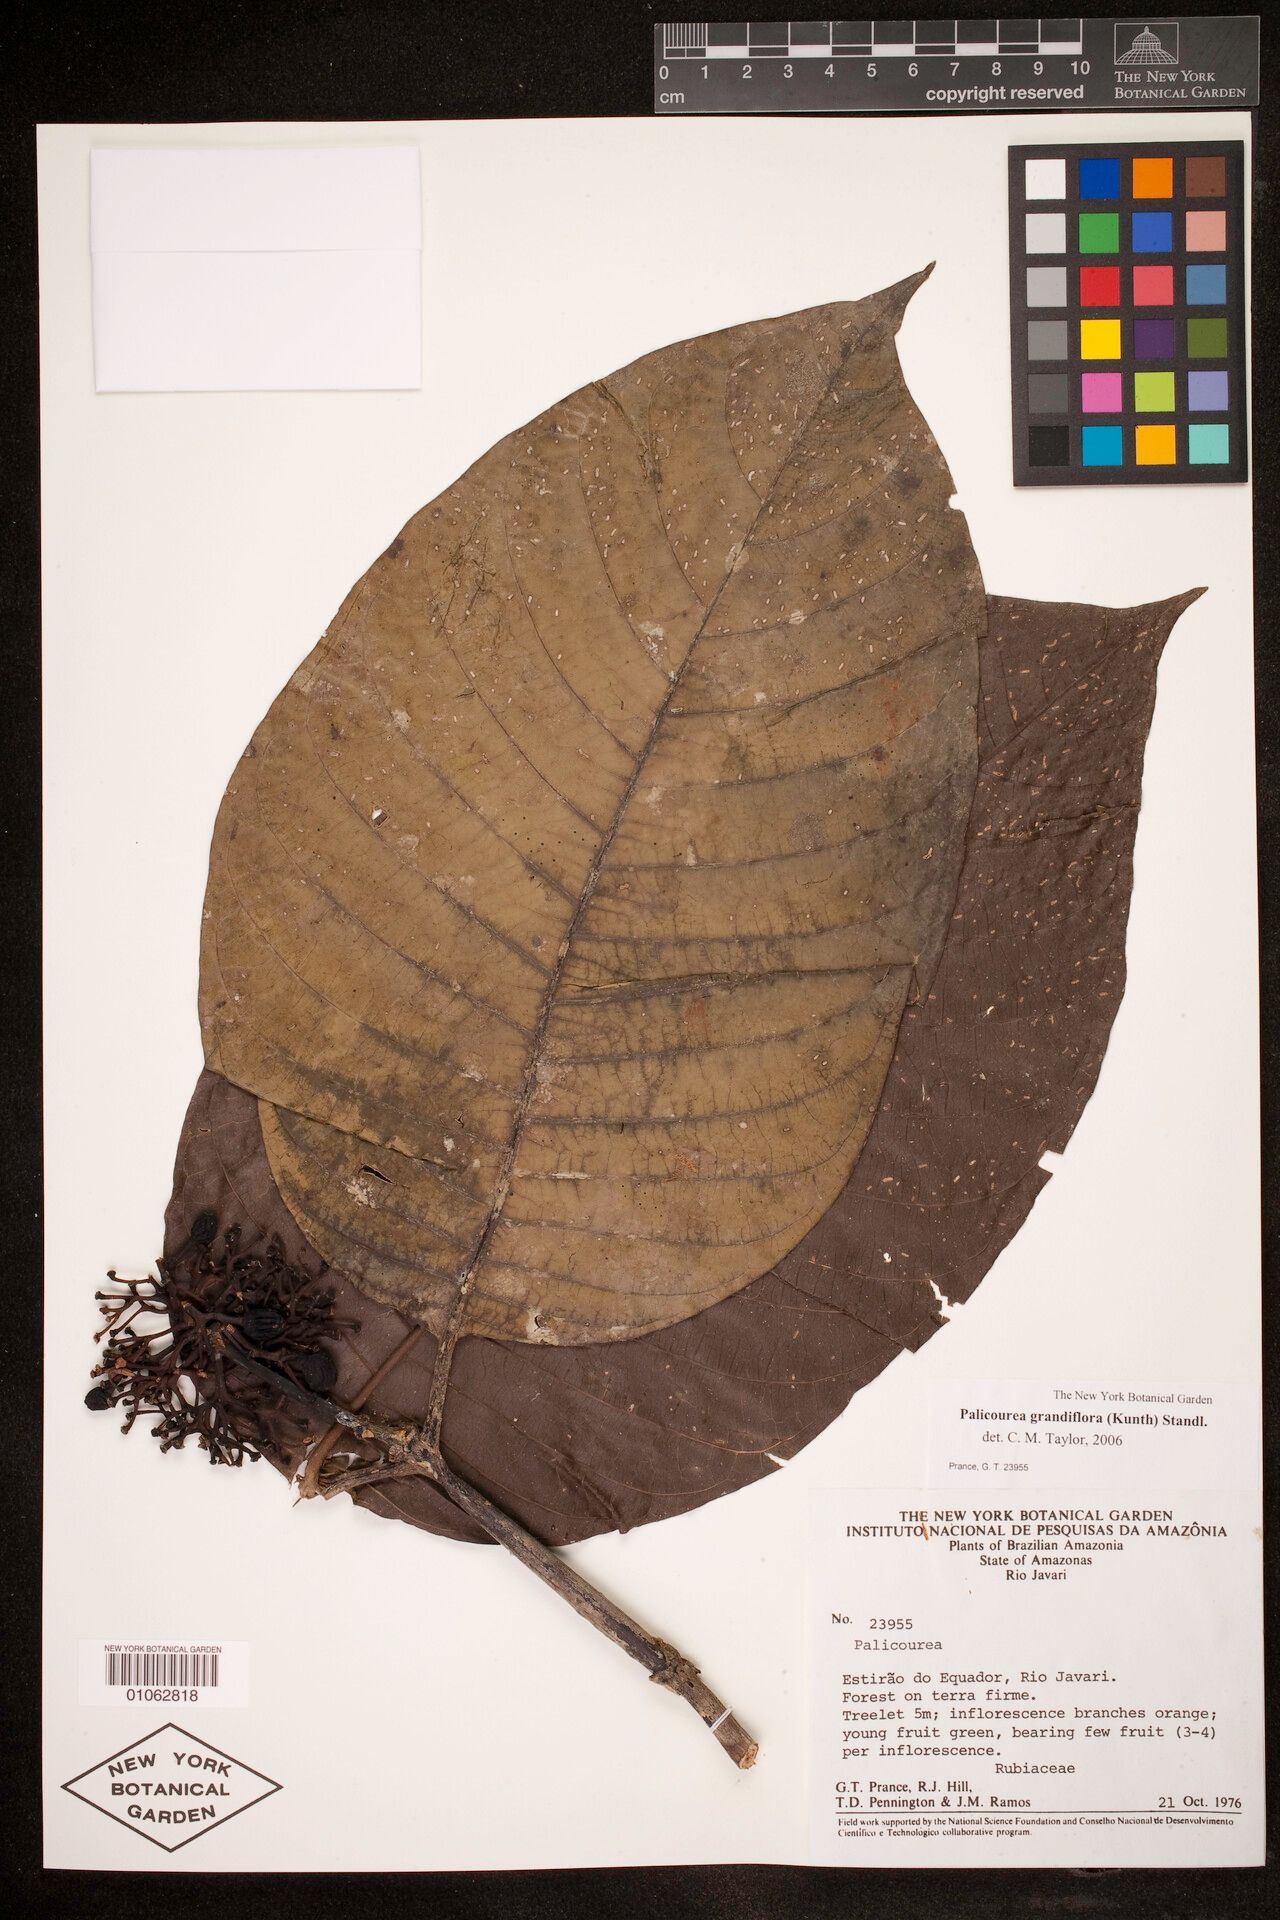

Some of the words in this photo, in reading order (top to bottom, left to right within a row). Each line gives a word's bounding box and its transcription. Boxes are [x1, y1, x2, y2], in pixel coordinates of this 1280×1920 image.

[659, 66, 669, 79] 0
[701, 65, 707, 79] 1
[743, 65, 752, 78] 2
[784, 64, 793, 78] 3
[825, 64, 834, 77] 4
[867, 63, 876, 77] 5
[908, 63, 918, 77] 6
[950, 63, 959, 76] 7
[992, 62, 1001, 76] 8
[1034, 61, 1043, 75] 9
[1071, 61, 1090, 74] 10
[660, 93, 684, 103] cm
[926, 86, 1006, 103] copyright
[1011, 85, 1083, 99] reserved
[1054, 1390, 1072, 1399] The
[1075, 1391, 1097, 1400] New
[1101, 1392, 1124, 1401] York
[1128, 1392, 1174, 1403] Botanical
[1177, 1395, 1212, 1404] Garden
[961, 1409, 1025, 1421] Palicourea
[1031, 1412, 1102, 1424] grandiflora
[1107, 1413, 1158, 1426] (Kunth)
[1163, 1415, 1207, 1426] Standl.
[983, 1431, 1003, 1442] det.
[1008, 1432, 1020, 1443] C.
[1025, 1432, 1040, 1443] M.
[1046, 1433, 1088, 1447] Taylor,
[1093, 1434, 1122, 1446] 2006
[949, 1462, 978, 1470] Prance,
[899, 1511, 928, 1522] THE
[935, 1511, 966, 1521] NEW
[973, 1510, 1013, 1521] YORK
[1020, 1510, 1103, 1521] BOTANICAL
[1109, 1510, 1172, 1521] GARDEN
[847, 1524, 924, 1537] INSTITUTO
[929, 1525, 1005, 1536] NACIONAL
[1012, 1525, 1030, 1535] DE
[1037, 1525, 1113, 1537] PESQUISAS
[1120, 1525, 1139, 1535] DA
[1147, 1522, 1227, 1537] AMAZÔNIA
[950, 1540, 984, 1551] Plants
[990, 1540, 1002, 1551] of
[1008, 1539, 1057, 1550] Brazilian
[1064, 1540, 1123, 1550] Amazonia
[980, 1555, 1008, 1565] State
[1014, 1554, 1027, 1565] of
[1032, 1555, 1092, 1565] Amazonas
[1007, 1569, 1026, 1580] Rio
[1032, 1569, 1066, 1580] Javari
[832, 1614, 852, 1624] No.
[870, 1619, 912, 1630] 23955
[146, 1645, 188, 1653] BOTANICAL
[855, 1640, 942, 1650] Palicourea
[843, 1673, 904, 1684] Estirão
[914, 1672, 931, 1683] do
[940, 1672, 1009, 1685] Equador,
[1021, 1671, 1047, 1682] Rio
[1056, 1670, 1116, 1682] Javari.
[127, 1689, 198, 1702] 01062818
[843, 1692, 895, 1702] Forest
[904, 1693, 922, 1701] on
[932, 1691, 975, 1701] terra
[986, 1689, 1035, 1700] firme.
[843, 1709, 904, 1720] Treelet
[915, 1708, 938, 1720] 5m;
[950, 1708, 1065, 1719] inflorescence
[1074, 1707, 1145, 1718] branches
[1155, 1710, 1216, 1721] orange;
[843, 1730, 887, 1741] young
[897, 1726, 940, 1738] fruit
[950, 1729, 1001, 1740] green,
[1012, 1726, 1074, 1740] bearing
[1085, 1726, 1110, 1737] few
[1120, 1726, 1164, 1737] fruit
[1177, 1726, 1215, 1739] (3-4)
[842, 1748, 869, 1759] per
[880, 1745, 1000, 1756] inflorescence.
[109, 1753, 156, 1777] NEW
[174, 1753, 232, 1777] YORK
[995, 1762, 1075, 1774] Rubiaceae
[112, 1783, 230, 1796] BOTANICAL
[836, 1782, 862, 1792] G.T.
[870, 1782, 911, 1793] Prance,
[919, 1781, 940, 1792] R.J.
[948, 1781, 972, 1793] Hill,
[836, 1797, 863, 1808] T.D.
[870, 1796, 934, 1810] Pennington
[941, 1796, 951, 1807] &
[957, 1796, 983, 1807] J.M.
[991, 1796, 1030, 1807] Ramos
[1159, 1797, 1175, 1808] 21
[1183, 1796, 1207, 1806] Oct.
[1216, 1797, 1241, 1808] 1976
[128, 1805, 215, 1824] GARDEN
[839, 1818, 857, 1826] Field
[882, 1818, 920, 1827] supported
[923, 1818, 932, 1827] by
[948, 1817, 982, 1825] National
[984, 1817, 1013, 1825] Science
[1015, 1817, 1060, 1825] Foundation
[1079, 1817, 1115, 1825] Conselho
[1166, 1817, 1233, 1825] Desenvolvimento
